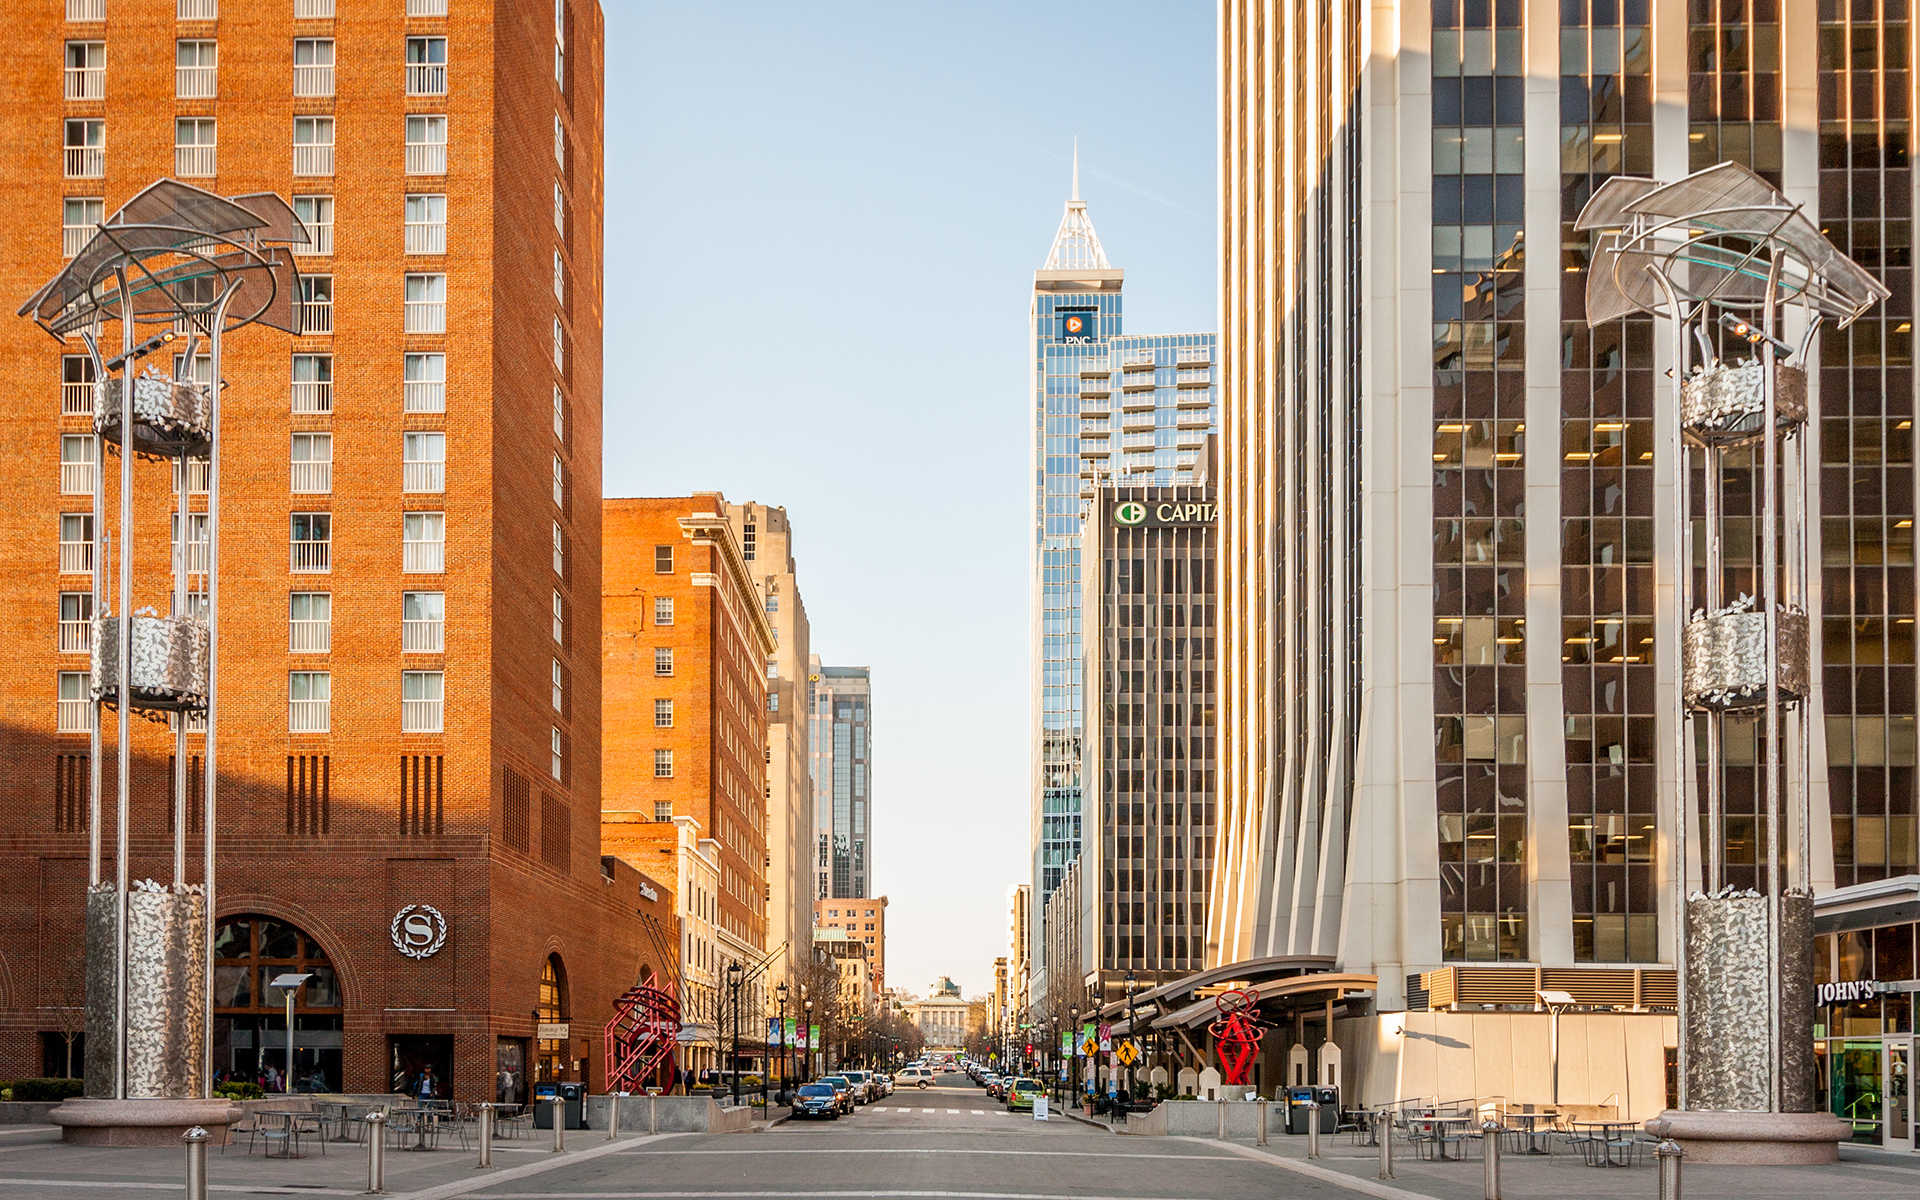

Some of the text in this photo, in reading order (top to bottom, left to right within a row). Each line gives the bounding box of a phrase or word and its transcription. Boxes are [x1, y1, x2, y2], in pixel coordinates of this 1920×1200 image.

[1065, 336, 1091, 345] PNC
[404, 914, 434, 946] S
[1816, 979, 1875, 1008] JOHN'S
